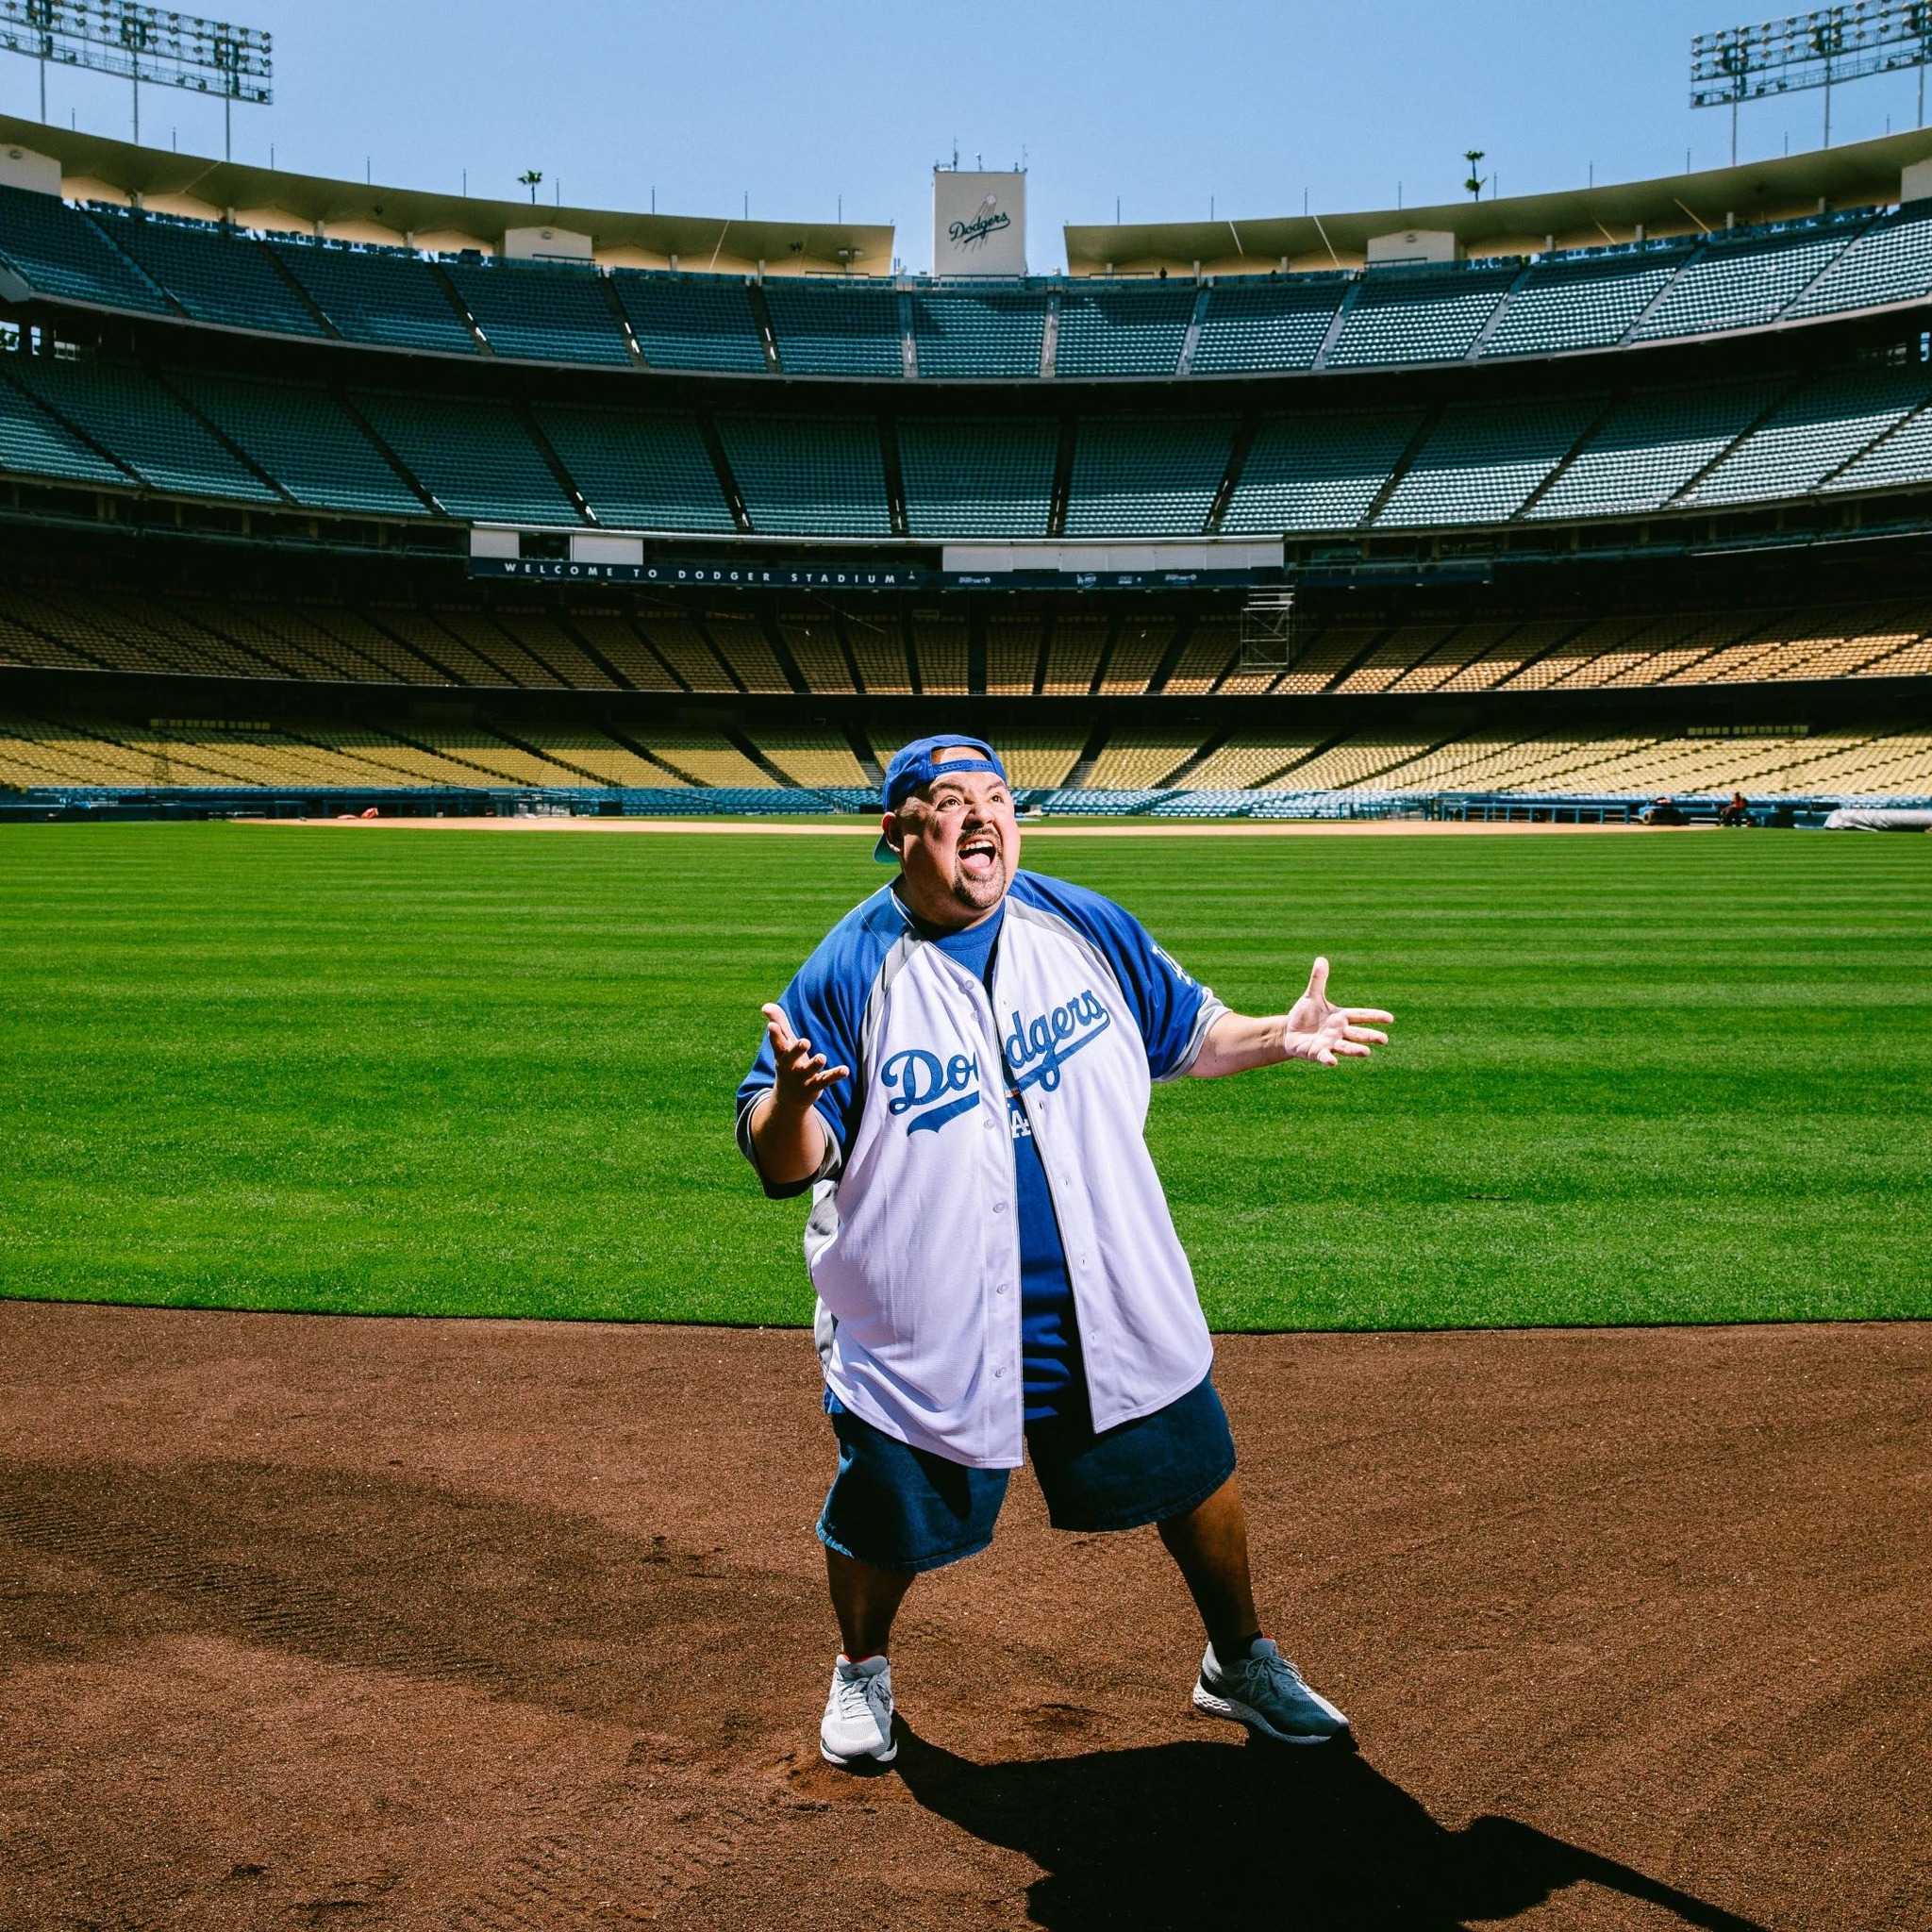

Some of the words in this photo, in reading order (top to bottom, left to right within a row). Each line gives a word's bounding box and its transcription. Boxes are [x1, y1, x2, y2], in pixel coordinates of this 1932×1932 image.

[948, 211, 1011, 244] Dodgers
[504, 562, 613, 577] WELCOME
[633, 568, 658, 578] TO
[677, 570, 771, 581] DODGER
[791, 573, 895, 583] STADIUM
[880, 989, 1111, 1138] Dodgers
[1007, 1103, 1032, 1139] A
